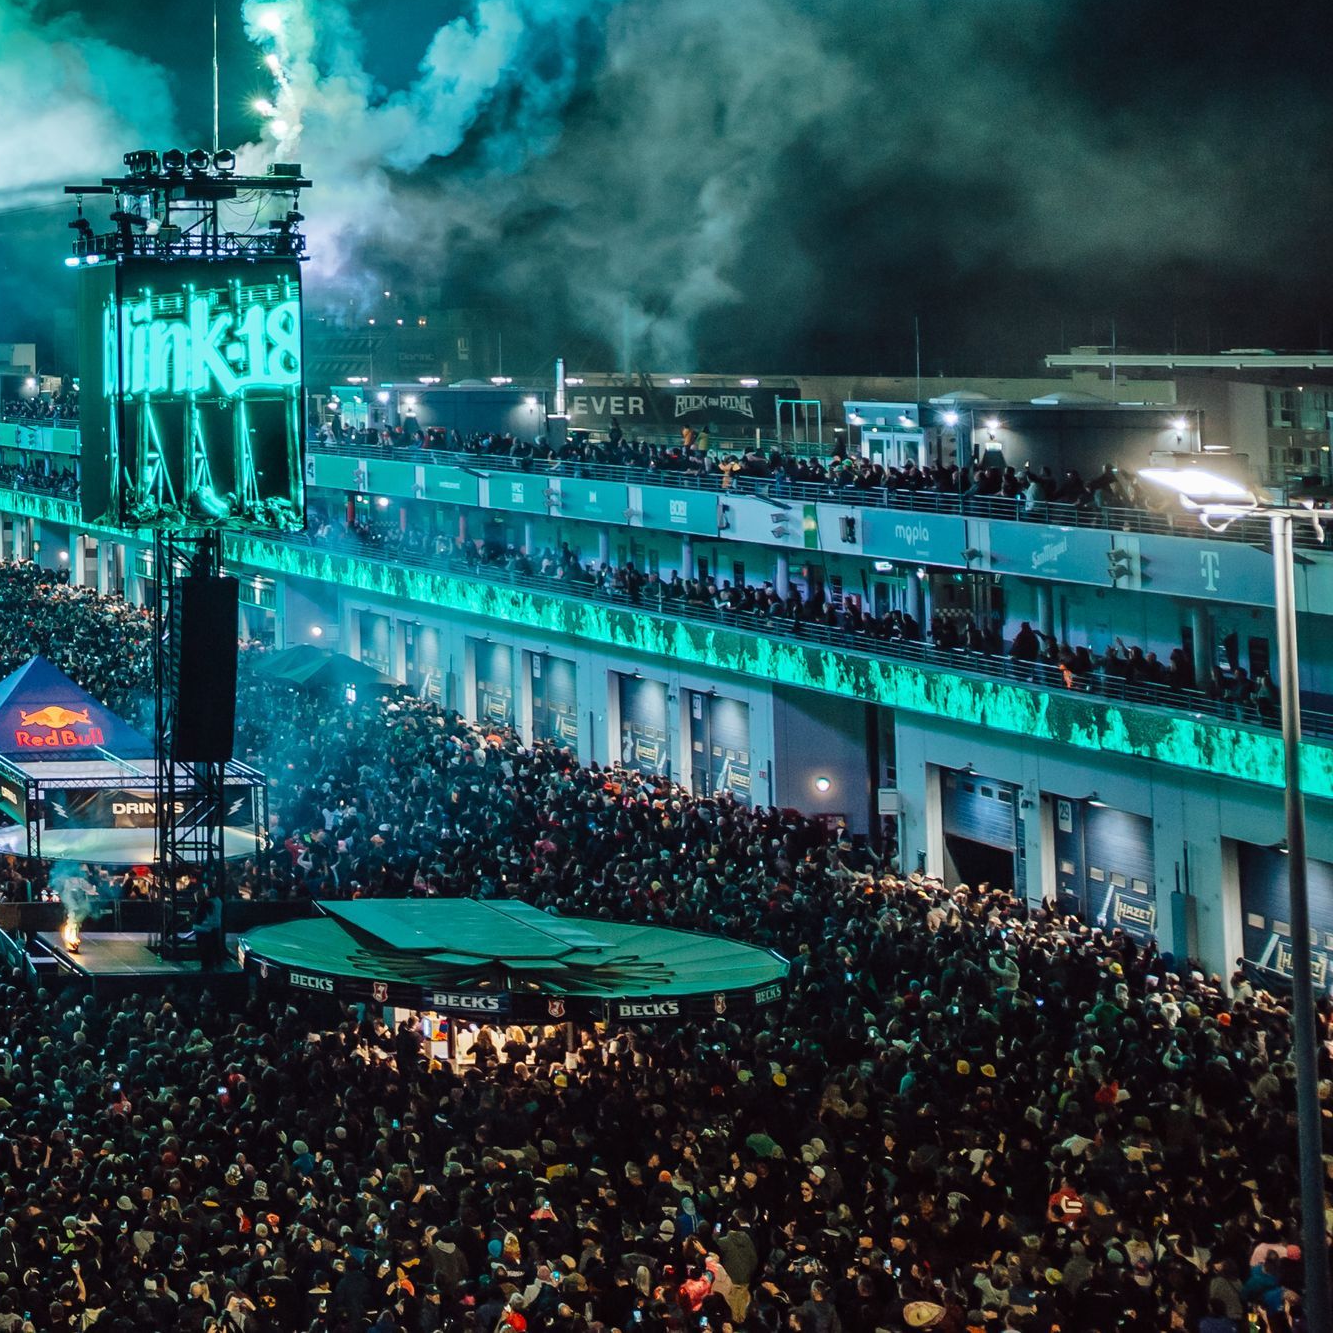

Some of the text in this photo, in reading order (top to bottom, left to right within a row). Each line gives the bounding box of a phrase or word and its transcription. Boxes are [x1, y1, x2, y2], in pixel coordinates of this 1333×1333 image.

[675, 395, 708, 418] ROCK
[720, 395, 754, 418] RING
[895, 521, 929, 547] mopla
[15, 726, 105, 747] Red Bull
[112, 802, 185, 815] DRINS
[1059, 801, 1070, 821] 29
[1119, 901, 1152, 922] HAZET
[290, 972, 334, 992] BECK'S
[433, 993, 499, 1011] BECK'S
[755, 985, 782, 1005] BECK'S
[619, 1001, 680, 1018] BECK'S
